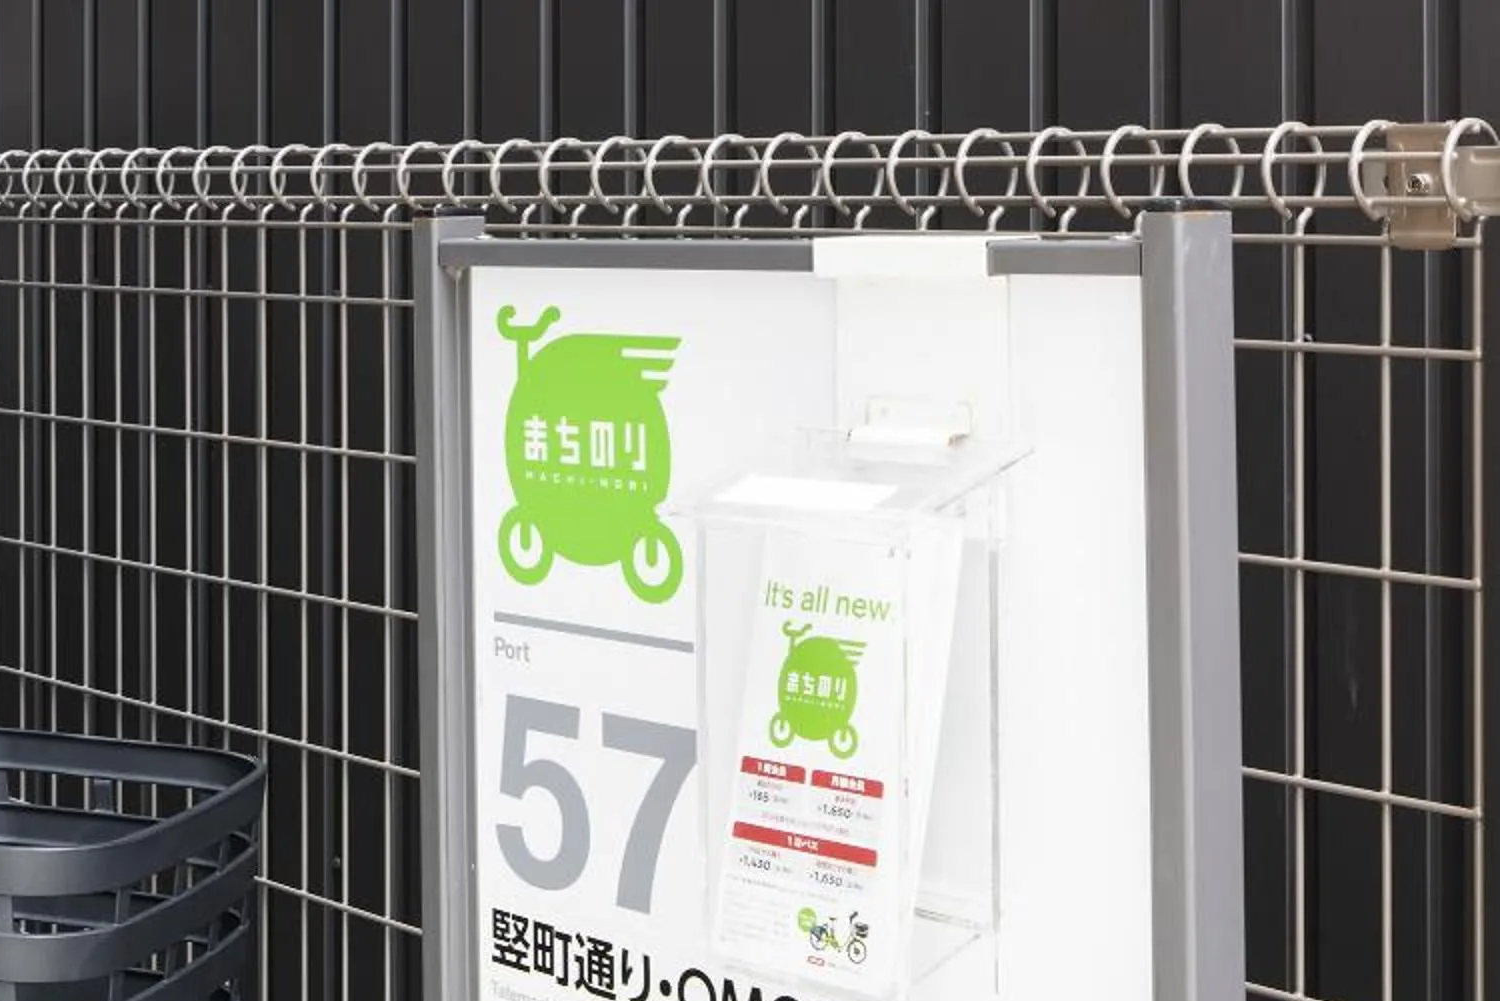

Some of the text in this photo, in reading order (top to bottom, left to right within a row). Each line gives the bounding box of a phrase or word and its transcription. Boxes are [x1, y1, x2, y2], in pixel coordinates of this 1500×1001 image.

[524, 415, 646, 470] まちのり
[764, 579, 794, 609] It's
[800, 585, 830, 614] all
[494, 636, 531, 662] Port
[786, 672, 847, 701] まちのり
[495, 693, 697, 915] 57
